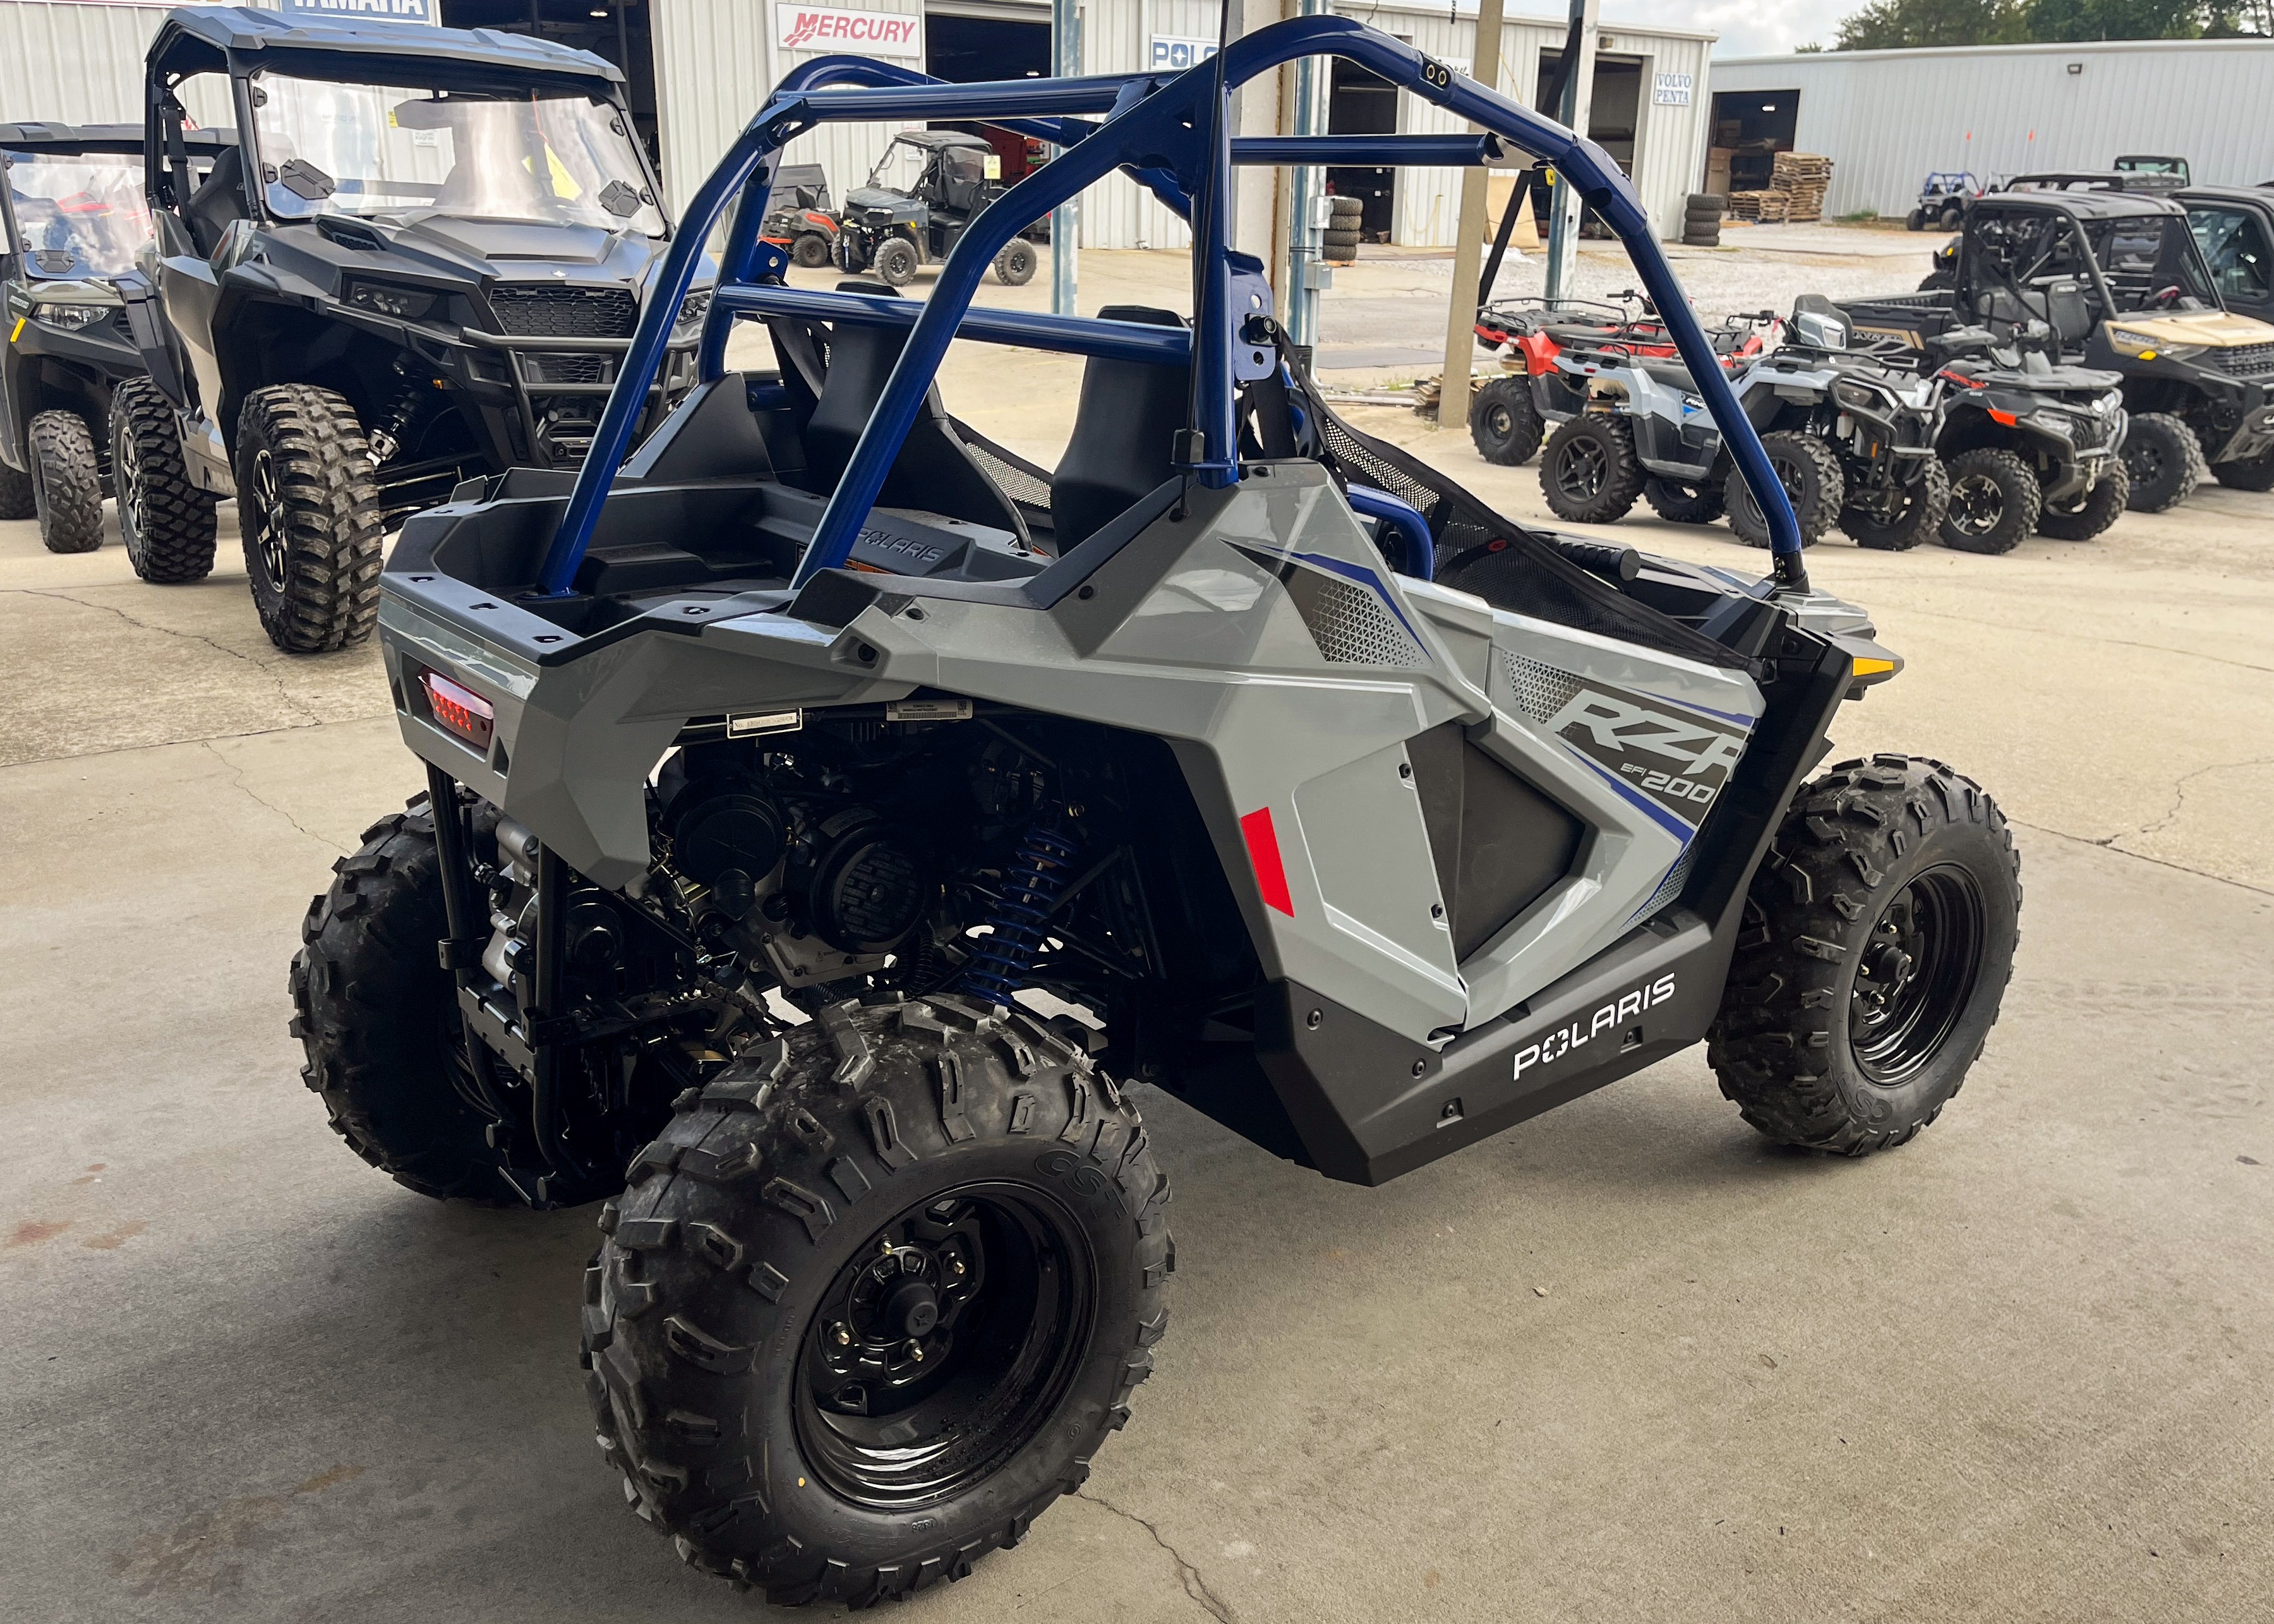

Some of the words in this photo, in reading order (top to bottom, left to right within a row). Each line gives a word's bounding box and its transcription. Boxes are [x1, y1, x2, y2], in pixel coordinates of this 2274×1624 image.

[783, 13, 915, 47] MERCURY
[1656, 90, 1688, 103] PENTA
[1657, 73, 1692, 88] VOLVO
[1620, 762, 1647, 776] EFI
[1641, 769, 1716, 804] 200
[1513, 972, 1676, 1081] POLARIS
[1836, 1071, 1893, 1126] CST
[1035, 1148, 1129, 1220] CST
